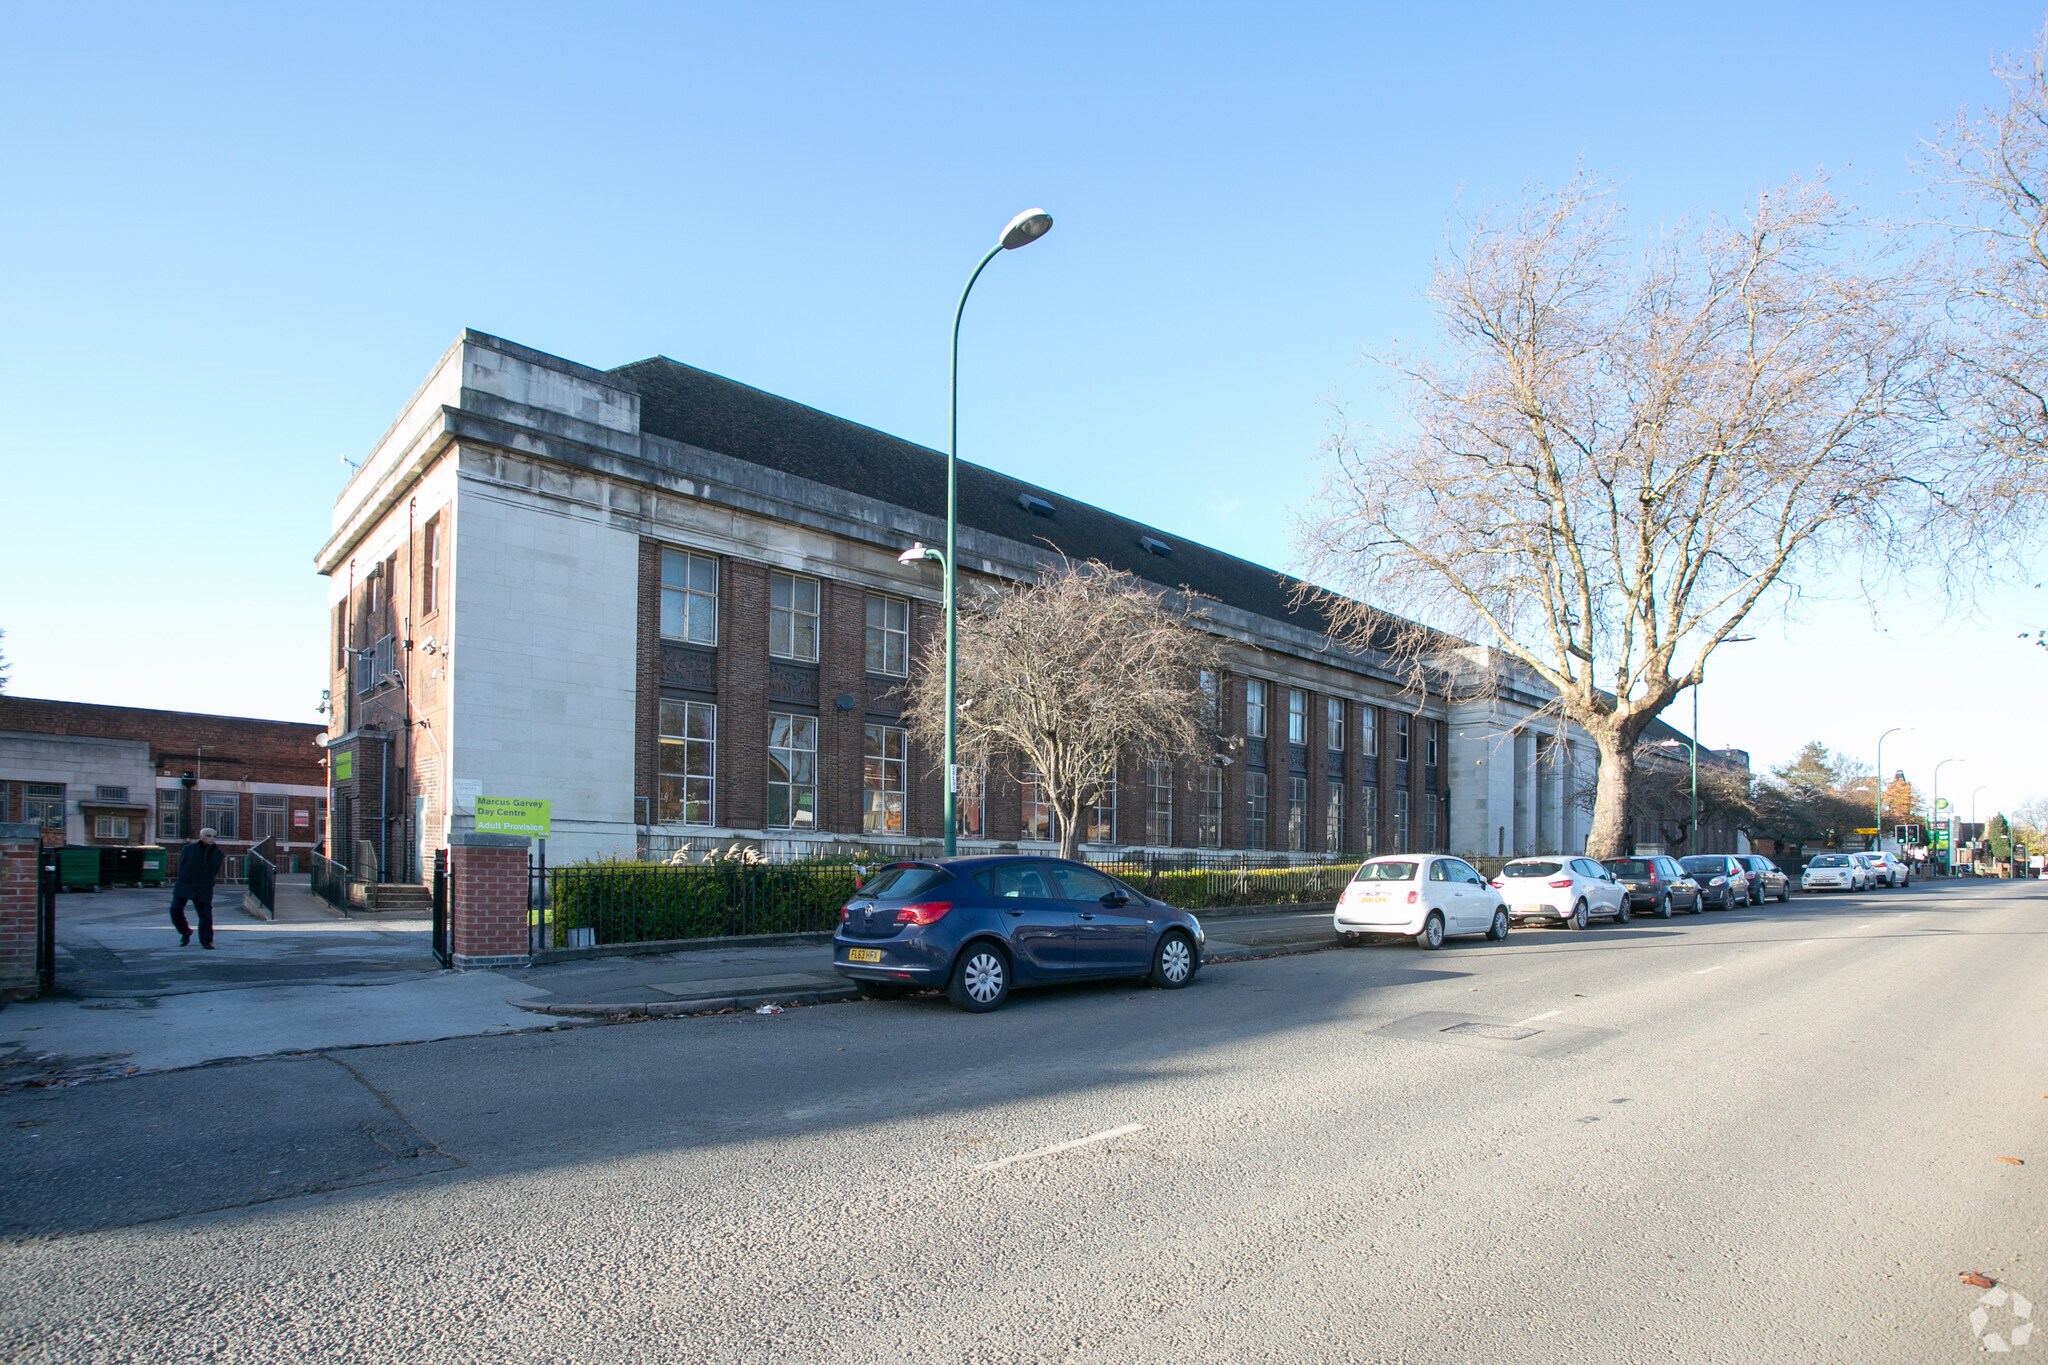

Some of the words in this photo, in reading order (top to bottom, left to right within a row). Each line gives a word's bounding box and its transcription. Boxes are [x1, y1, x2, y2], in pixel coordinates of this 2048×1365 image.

[477, 797, 510, 806] Marcus
[513, 799, 543, 809] Garvey
[477, 808, 495, 817] Day
[497, 808, 526, 817] Centre
[503, 822, 544, 831] Provision
[850, 949, 865, 959] FL63
